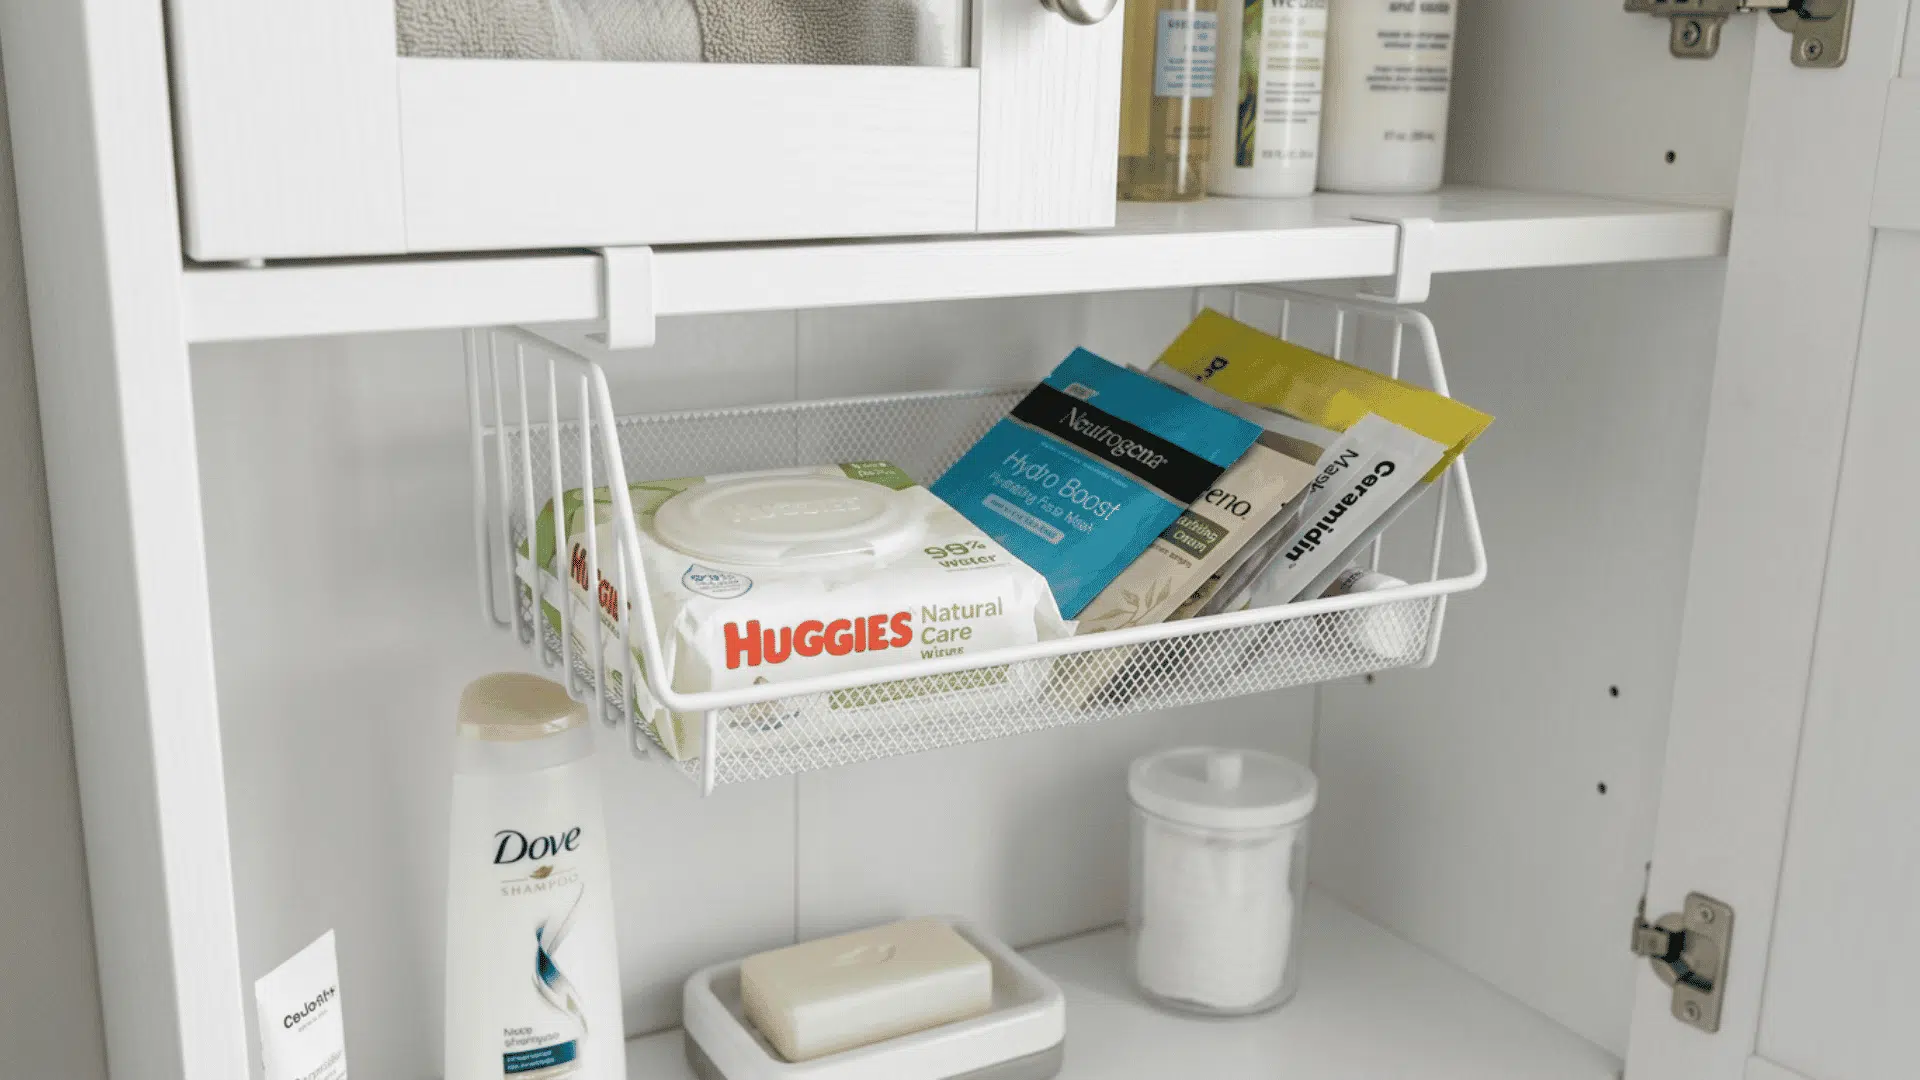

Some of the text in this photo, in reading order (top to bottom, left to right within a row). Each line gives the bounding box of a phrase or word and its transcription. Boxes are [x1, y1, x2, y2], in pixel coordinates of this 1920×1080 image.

[1059, 406, 1163, 470] Neutrogena
[1002, 449, 1060, 489] Hydro
[1059, 477, 1121, 521] Boost
[1285, 460, 1396, 563] Ceramidin
[924, 539, 987, 560] 99%
[921, 595, 1004, 624] Natural
[724, 611, 914, 670] HUGGIES
[920, 625, 973, 645] Care
[493, 826, 582, 865] Dove
[500, 873, 579, 898] SHAMPOO
